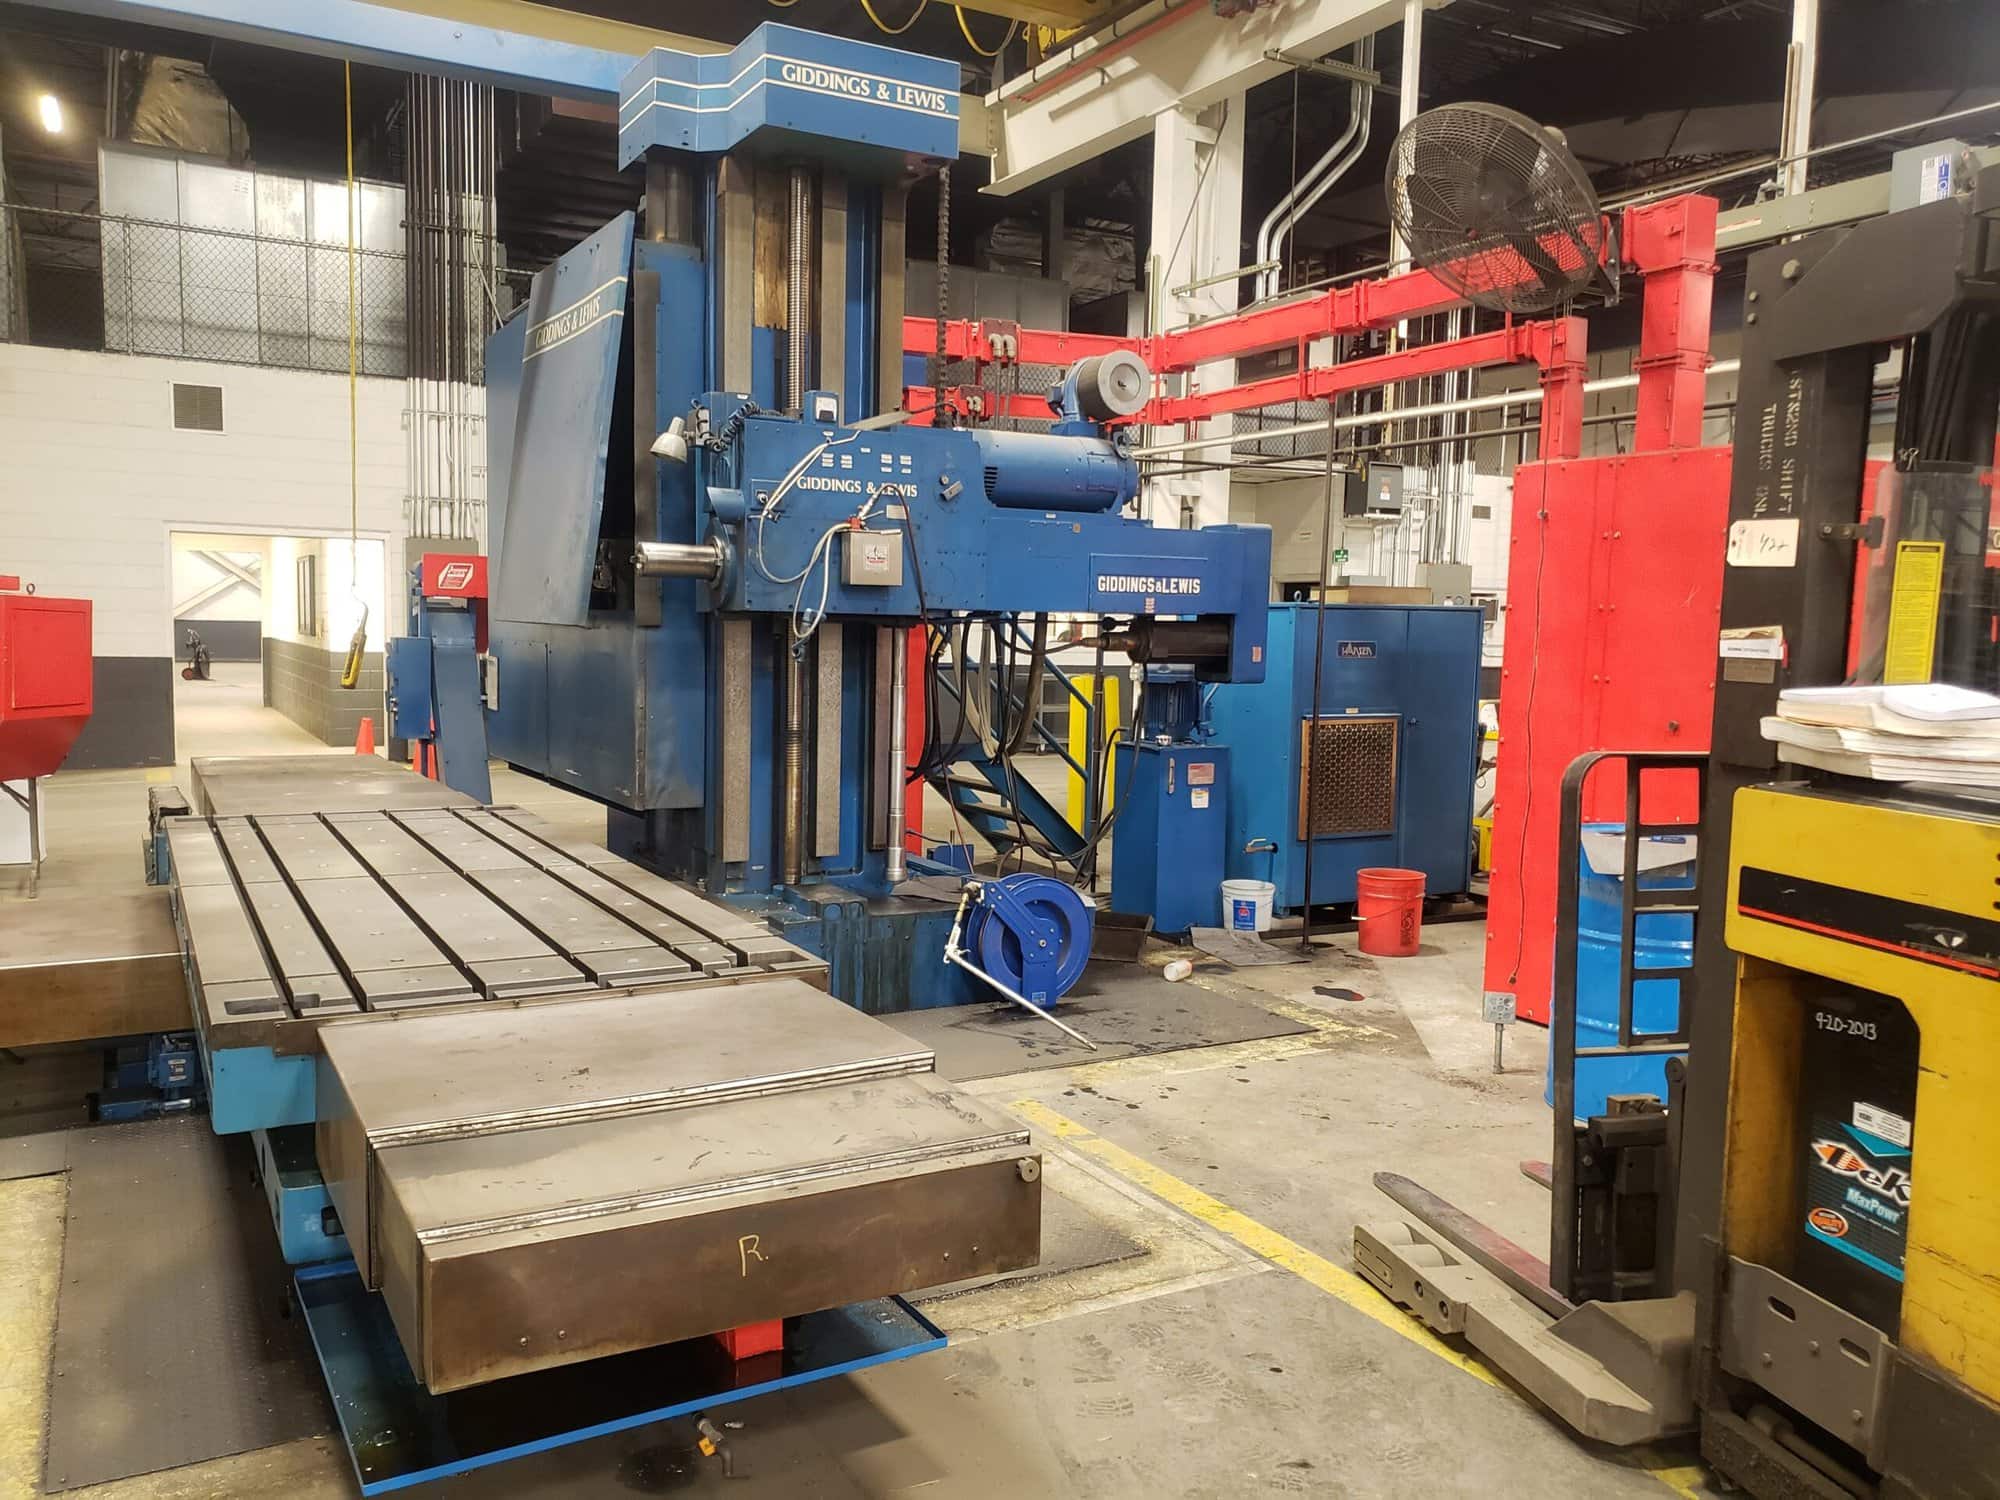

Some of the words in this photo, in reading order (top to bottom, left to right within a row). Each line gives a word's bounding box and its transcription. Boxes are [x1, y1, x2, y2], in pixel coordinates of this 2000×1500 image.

[782, 64, 870, 96] GIDDINGS
[876, 83, 890, 100] &
[1759, 403, 1777, 471] TRUCKS
[797, 476, 862, 493] GIDDINGS
[866, 482, 877, 494] &
[1778, 458, 1796, 513] SHIFT
